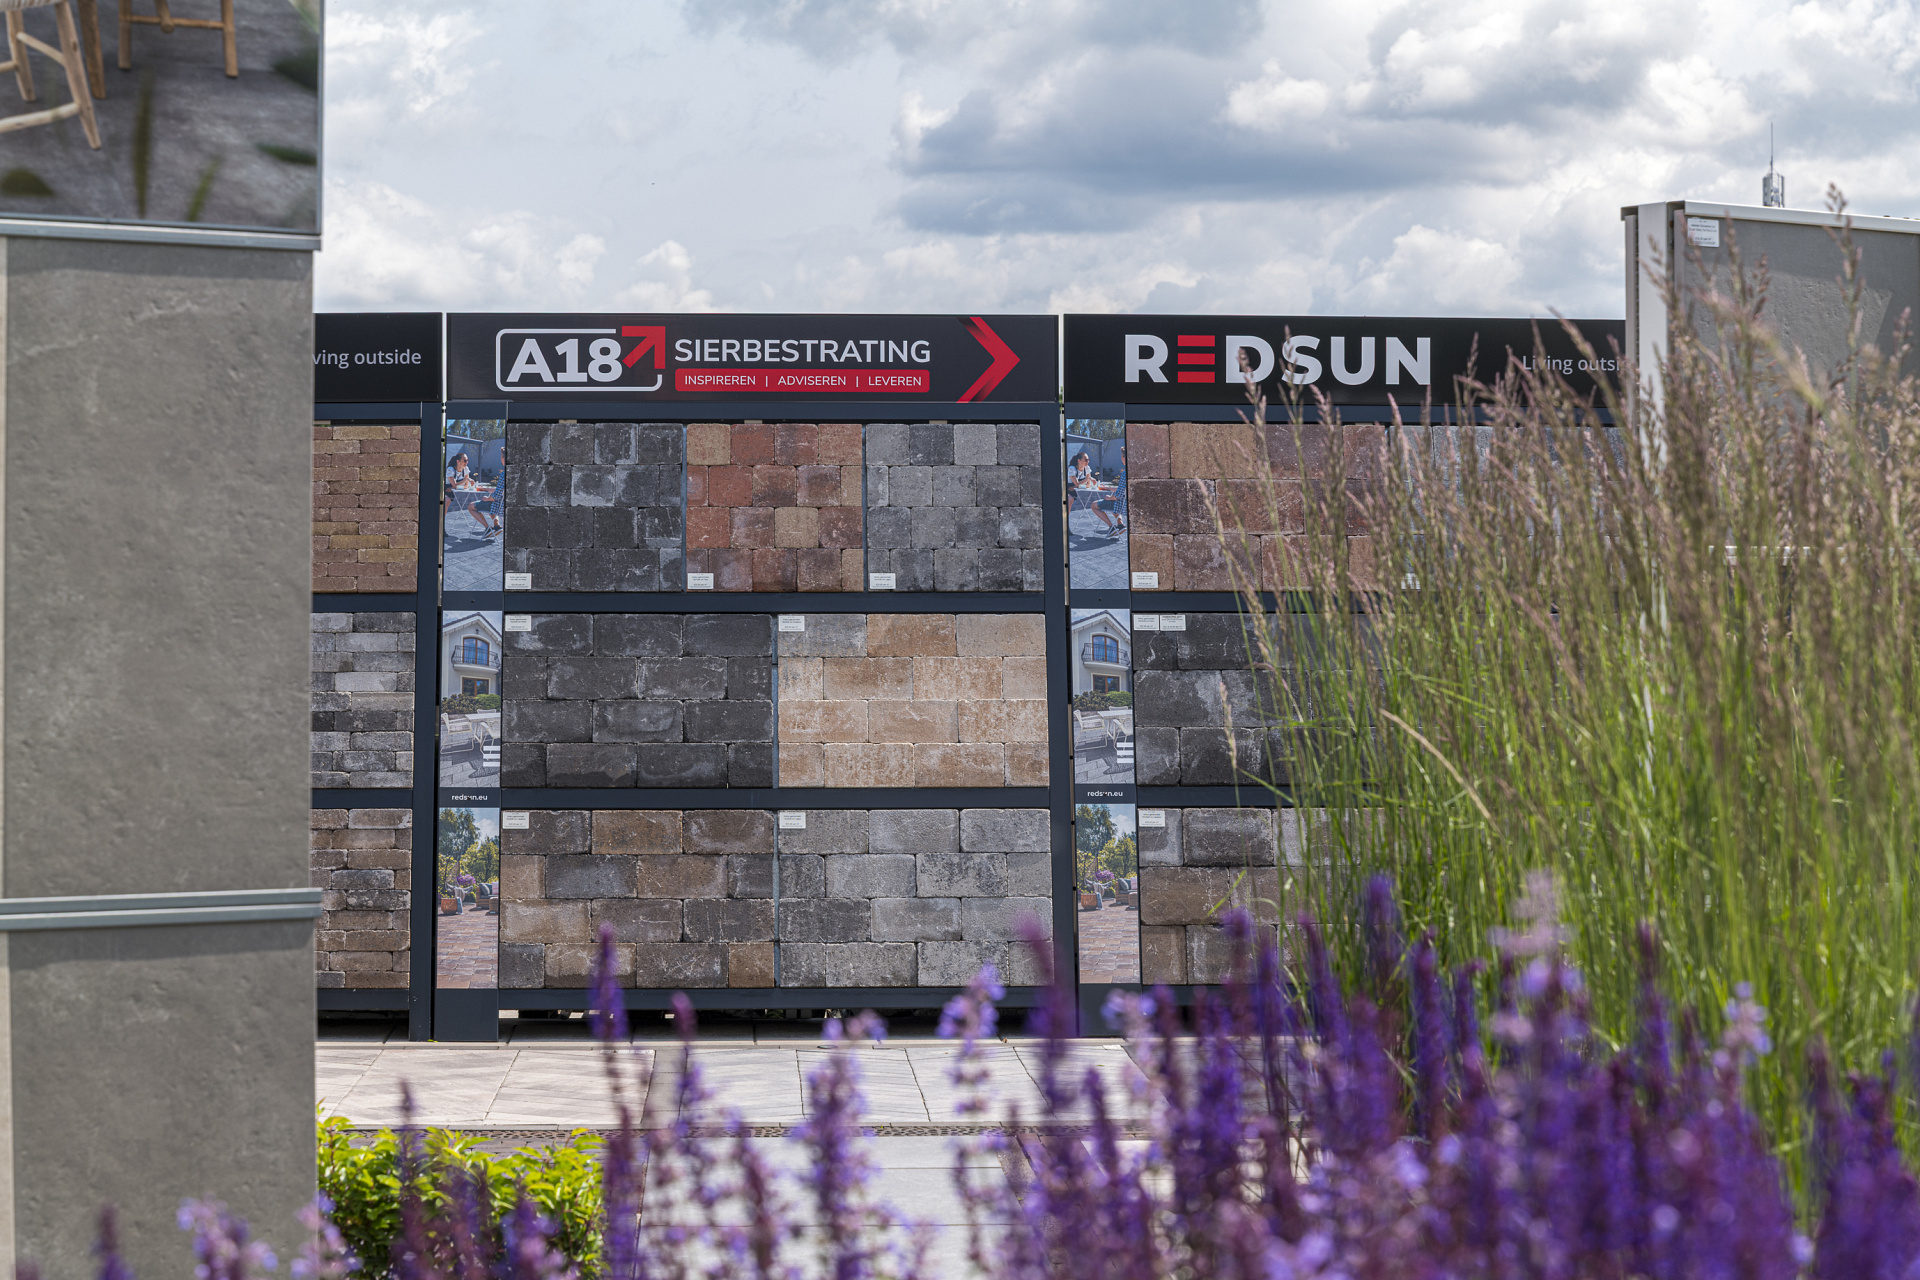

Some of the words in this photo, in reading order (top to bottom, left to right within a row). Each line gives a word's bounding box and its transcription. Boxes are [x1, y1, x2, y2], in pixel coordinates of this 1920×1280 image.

[354, 349, 422, 365] outside
[506, 338, 623, 383] A18
[674, 338, 931, 363] SIERBESTRATING
[1124, 334, 1431, 386] REDSUN
[1522, 355, 1573, 375] Liing
[684, 374, 756, 386] INSPIREREN
[777, 374, 847, 387] ADVISEREN
[867, 375, 923, 387] LEVEREN
